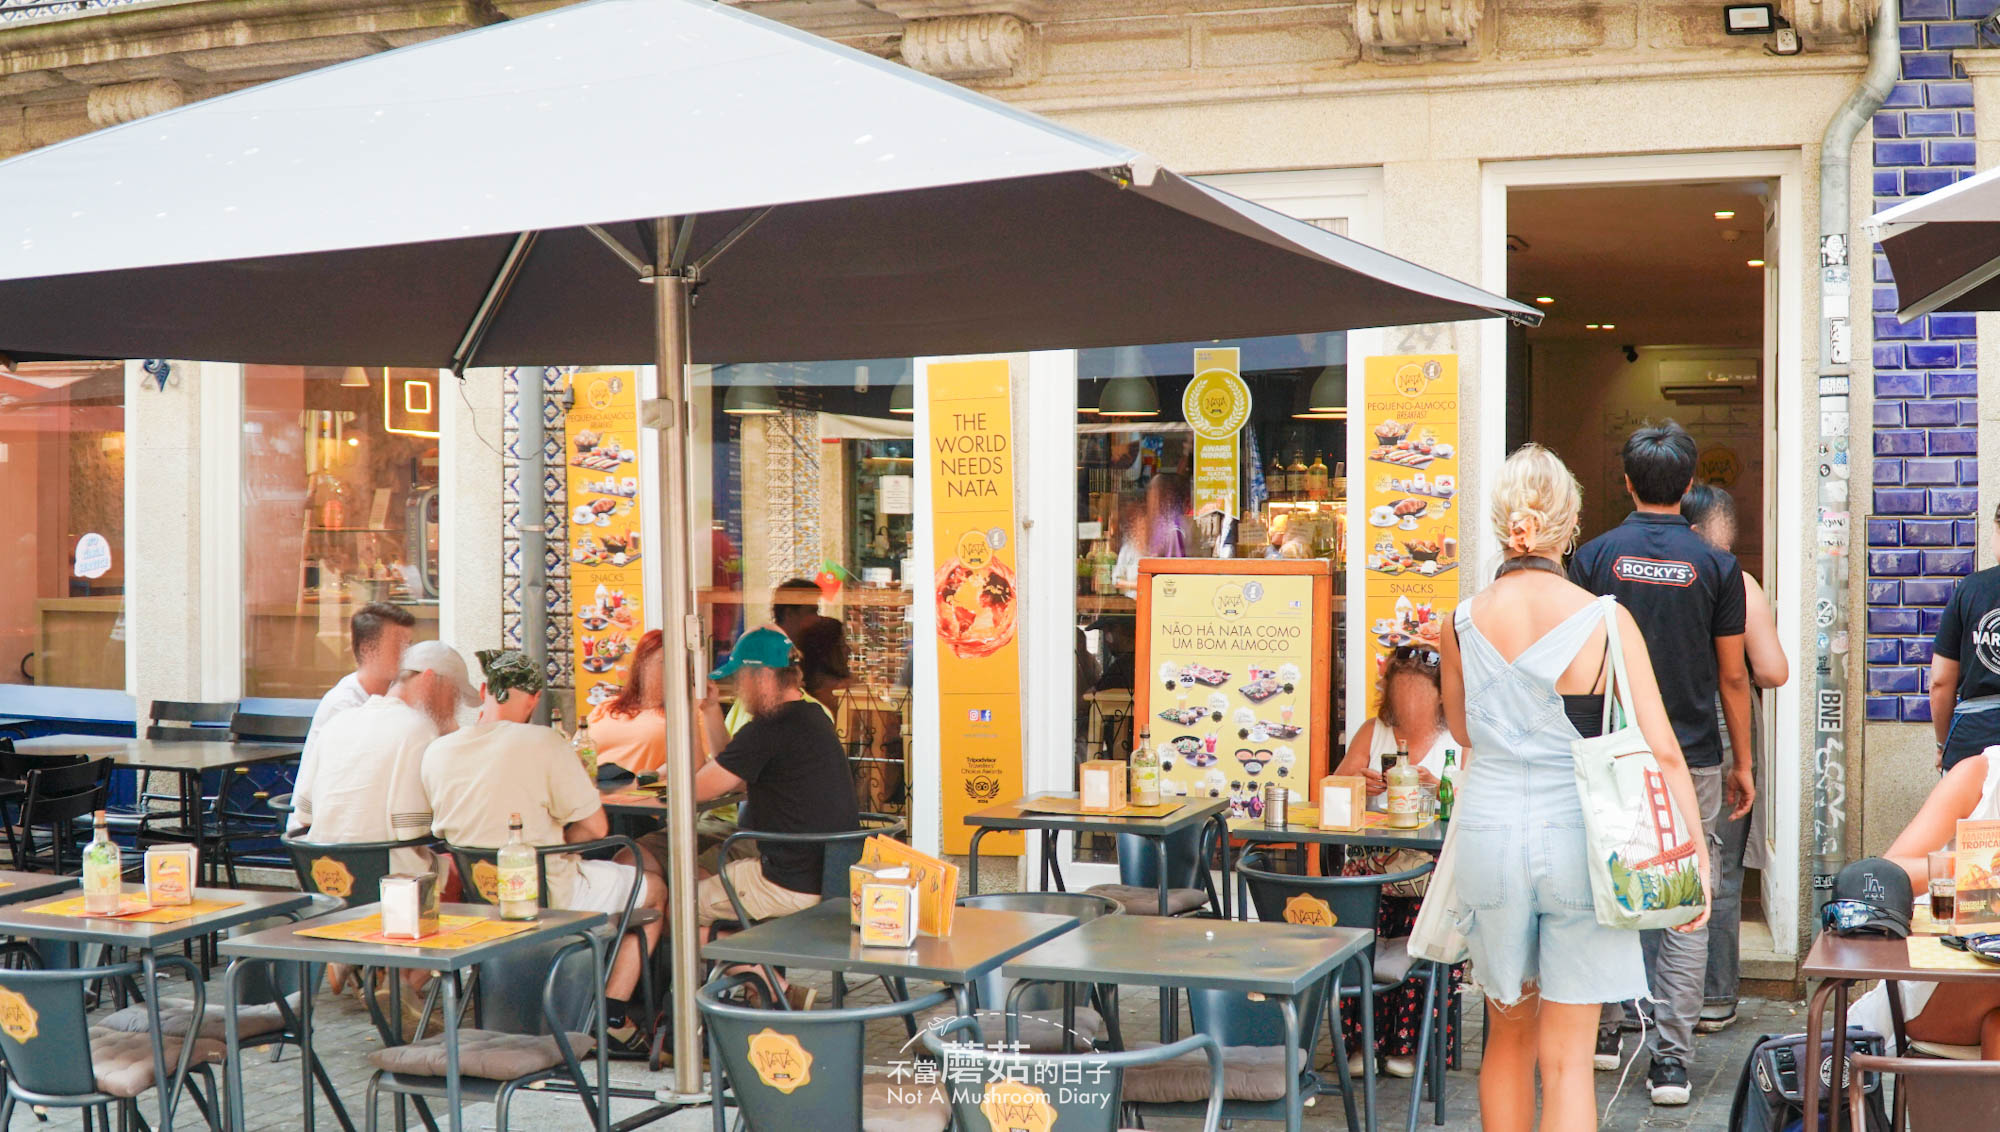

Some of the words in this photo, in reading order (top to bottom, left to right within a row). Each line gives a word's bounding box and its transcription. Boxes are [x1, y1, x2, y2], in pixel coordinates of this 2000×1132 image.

[953, 412, 987, 431] THE
[935, 435, 1006, 453] WORLD
[941, 456, 1003, 476] NEEDS
[948, 479, 998, 497] NATA
[590, 573, 624, 583] SNACKS
[1622, 563, 1687, 579] ROCKY'S
[1390, 583, 1434, 594] SNACKS
[1162, 621, 1192, 636] NÃO
[1196, 622, 1214, 636] HÁ
[1219, 625, 1252, 637] NATA
[1256, 625, 1301, 638] COMO
[1172, 638, 1193, 650] UM
[1197, 638, 1227, 650] BOM
[1231, 638, 1289, 653] ALMOÇO
[1820, 692, 1841, 730] BNE
